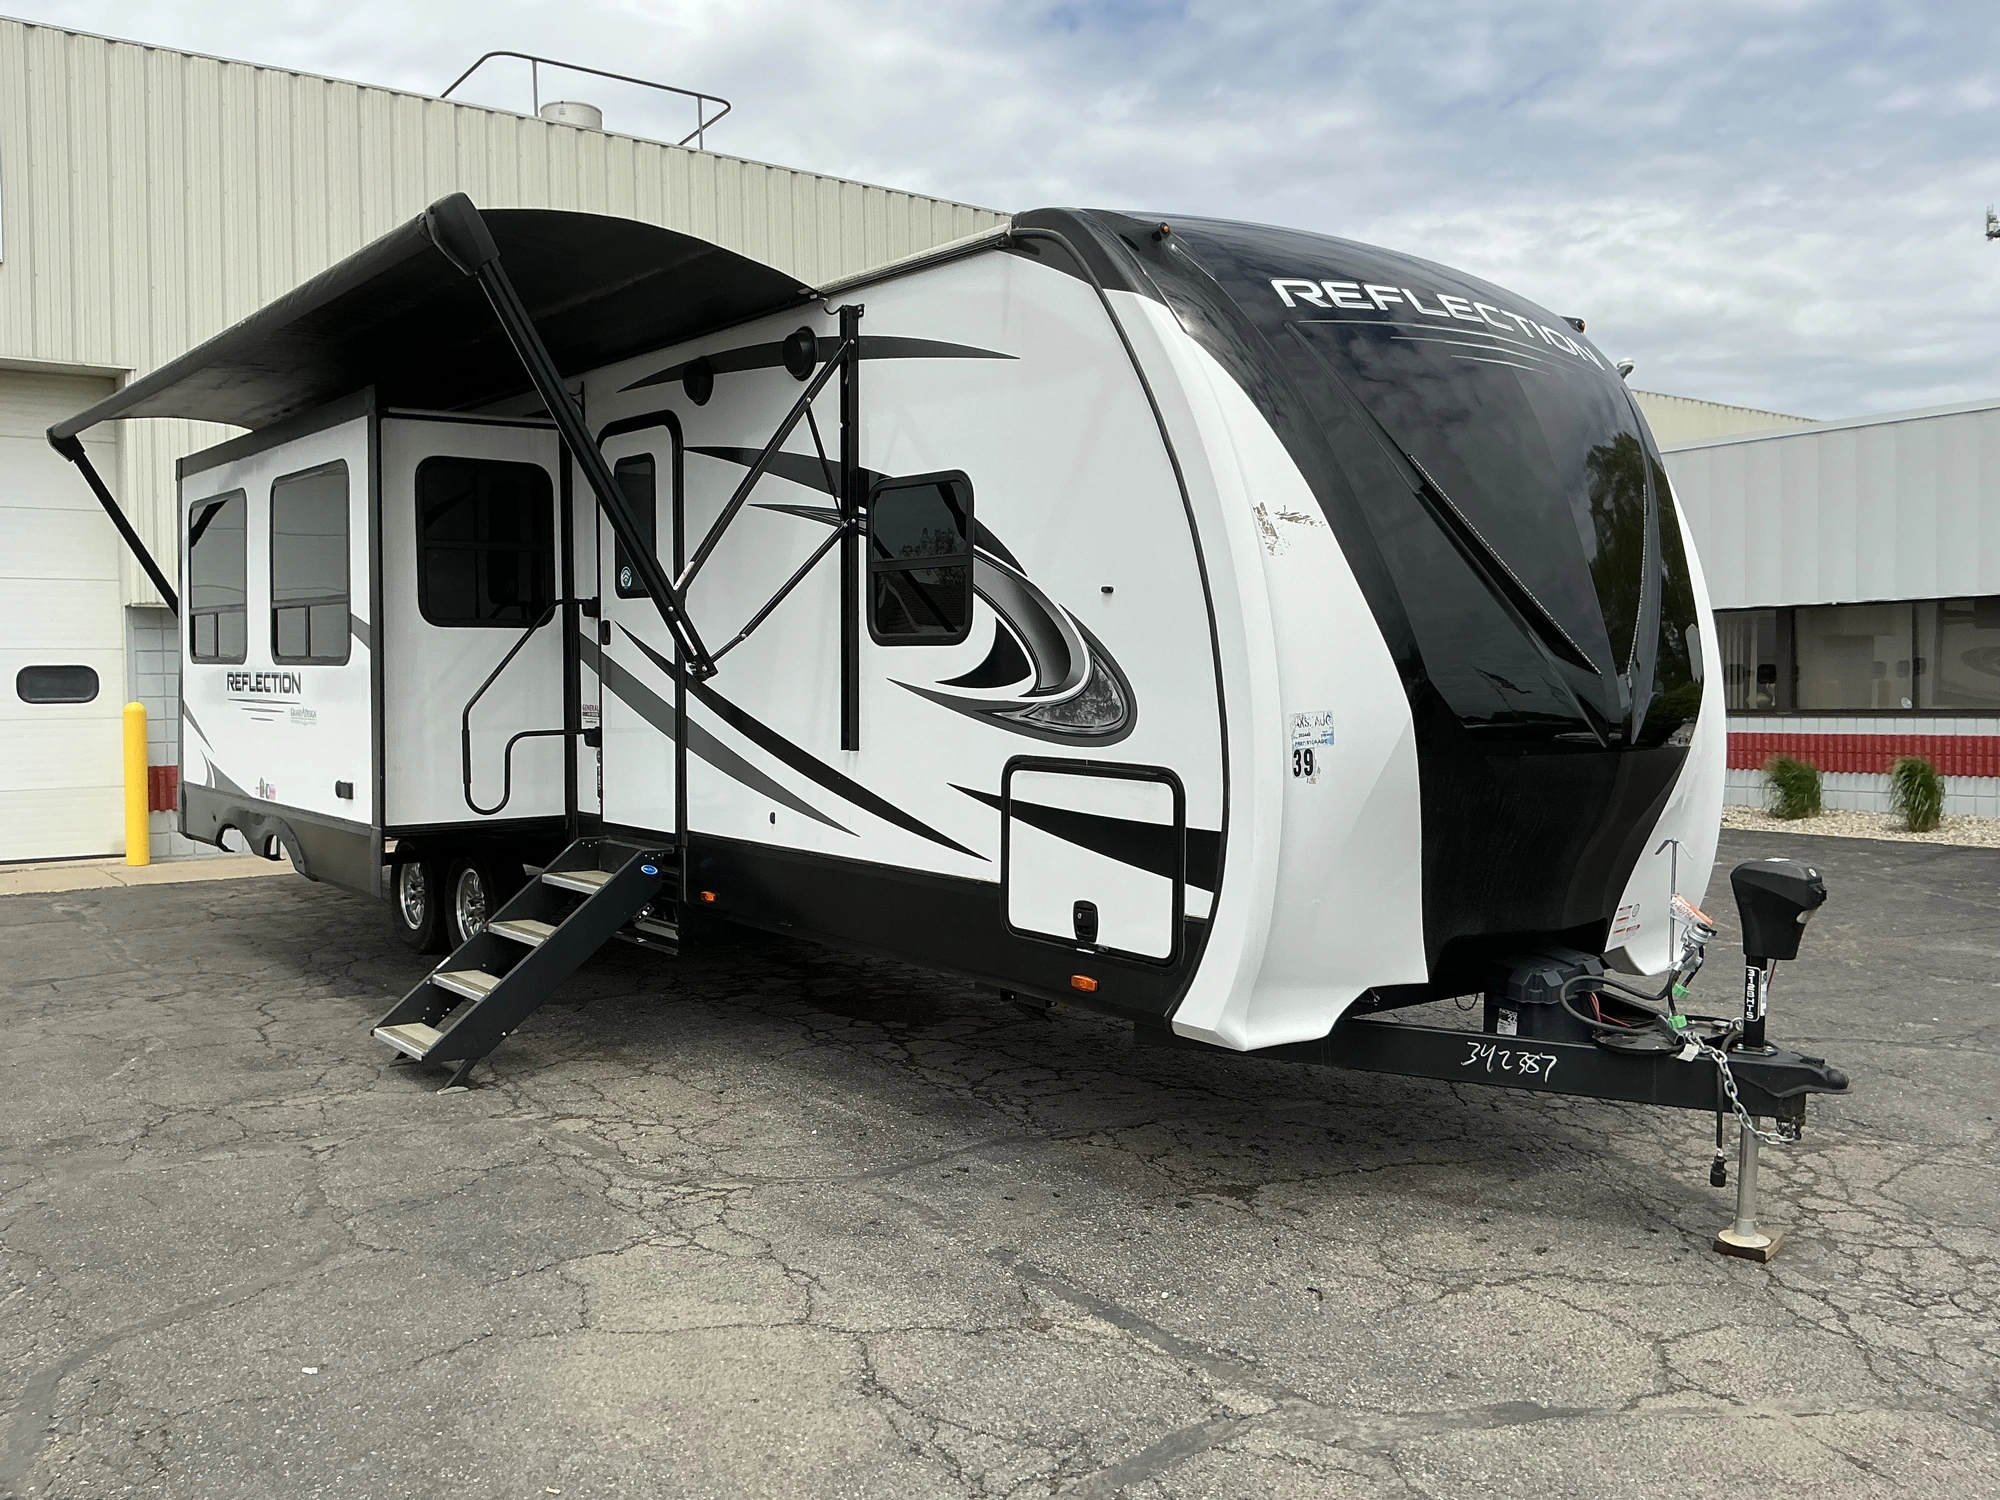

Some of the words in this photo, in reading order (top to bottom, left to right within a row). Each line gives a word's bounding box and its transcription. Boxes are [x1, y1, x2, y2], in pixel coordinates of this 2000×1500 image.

[1269, 278, 1605, 371] REFLECTION
[227, 672, 301, 694] REFLECTION
[1293, 748, 1314, 777] 39
